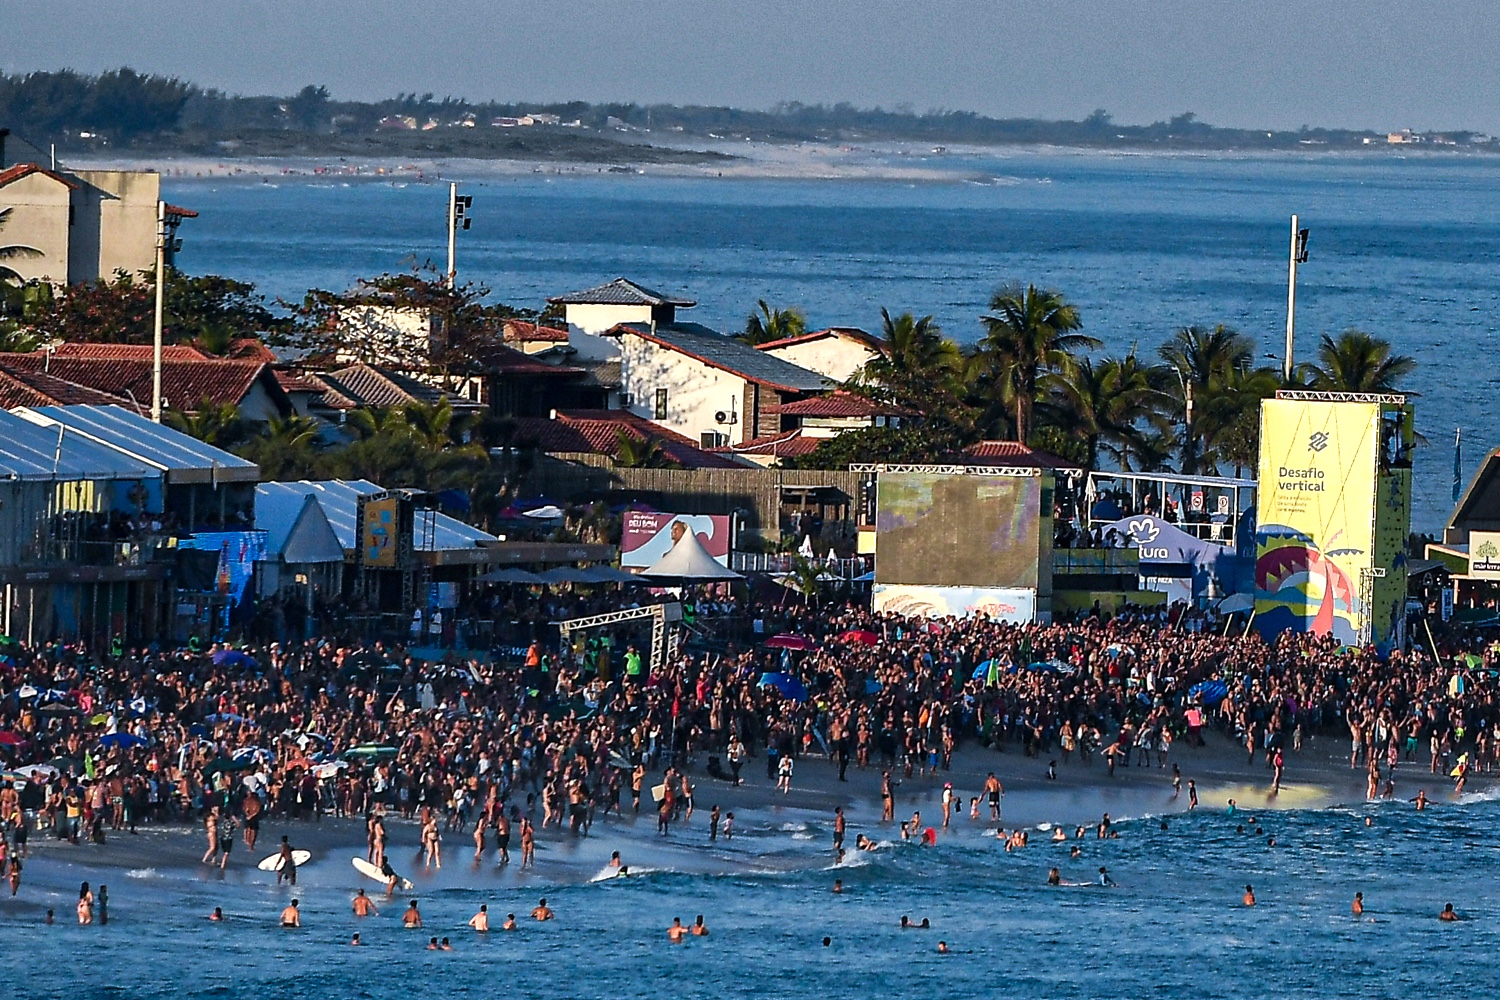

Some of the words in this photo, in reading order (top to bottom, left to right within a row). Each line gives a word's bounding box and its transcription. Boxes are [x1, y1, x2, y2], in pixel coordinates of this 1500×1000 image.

[1279, 467, 1325, 478] Desafio
[1278, 480, 1325, 491] vertical
[1138, 544, 1168, 559] tura
